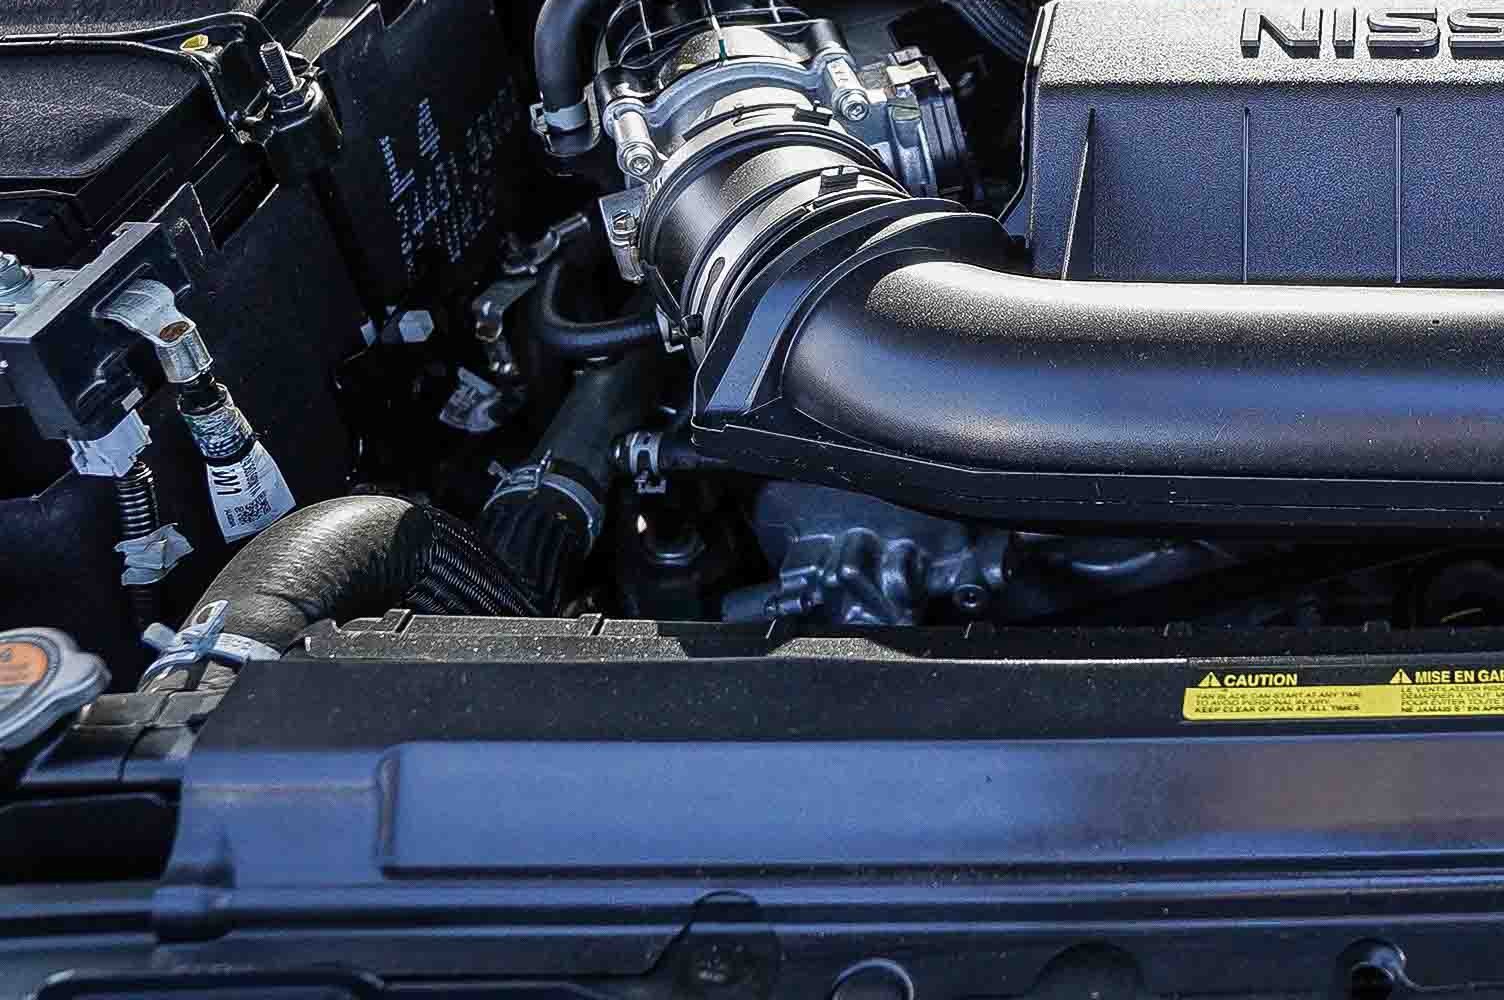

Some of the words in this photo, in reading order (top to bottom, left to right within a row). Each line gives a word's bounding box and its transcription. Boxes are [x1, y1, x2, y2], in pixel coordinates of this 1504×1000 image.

[1224, 673, 1298, 687] CAUTION
[1415, 671, 1450, 683] MISE
[1455, 671, 1474, 682] EN
